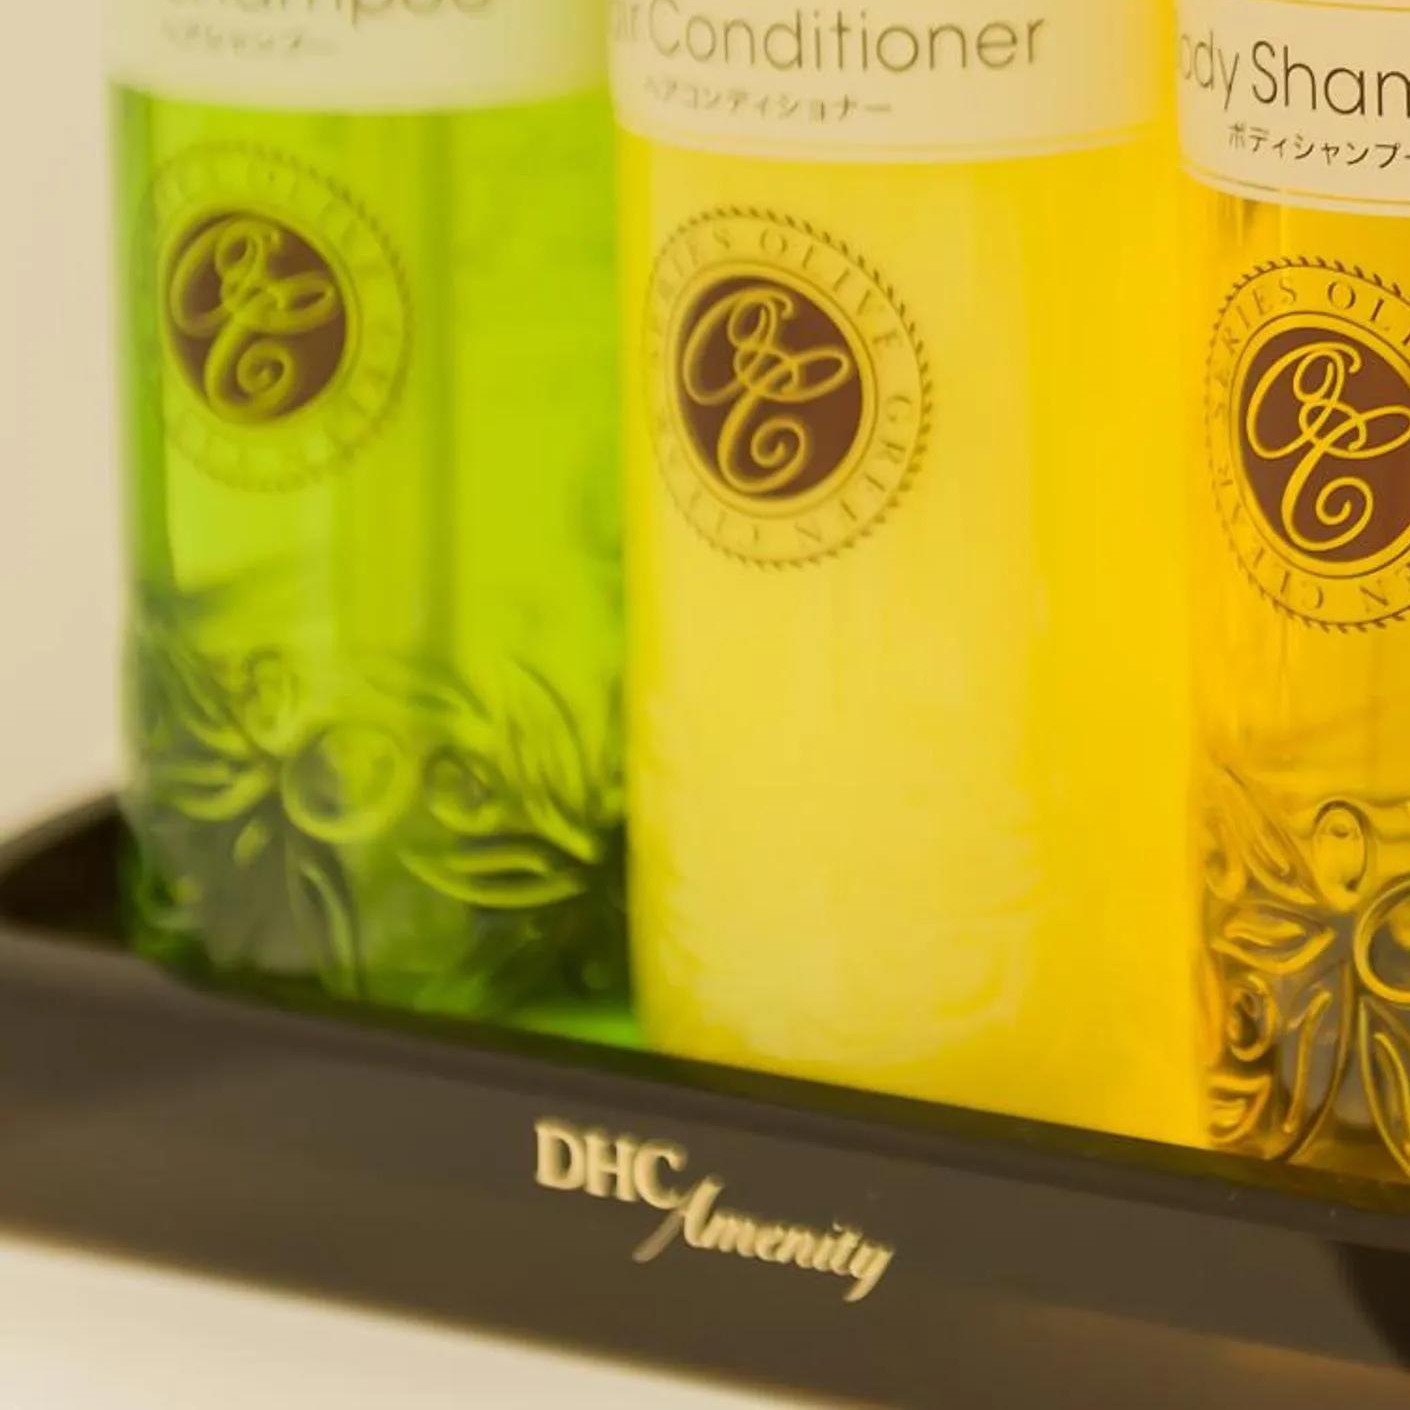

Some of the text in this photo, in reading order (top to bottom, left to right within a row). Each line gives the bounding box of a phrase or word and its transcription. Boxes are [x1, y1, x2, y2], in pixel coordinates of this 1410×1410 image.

[1178, 28, 1240, 112] ody
[534, 1115, 896, 1303] DHC Amenity
